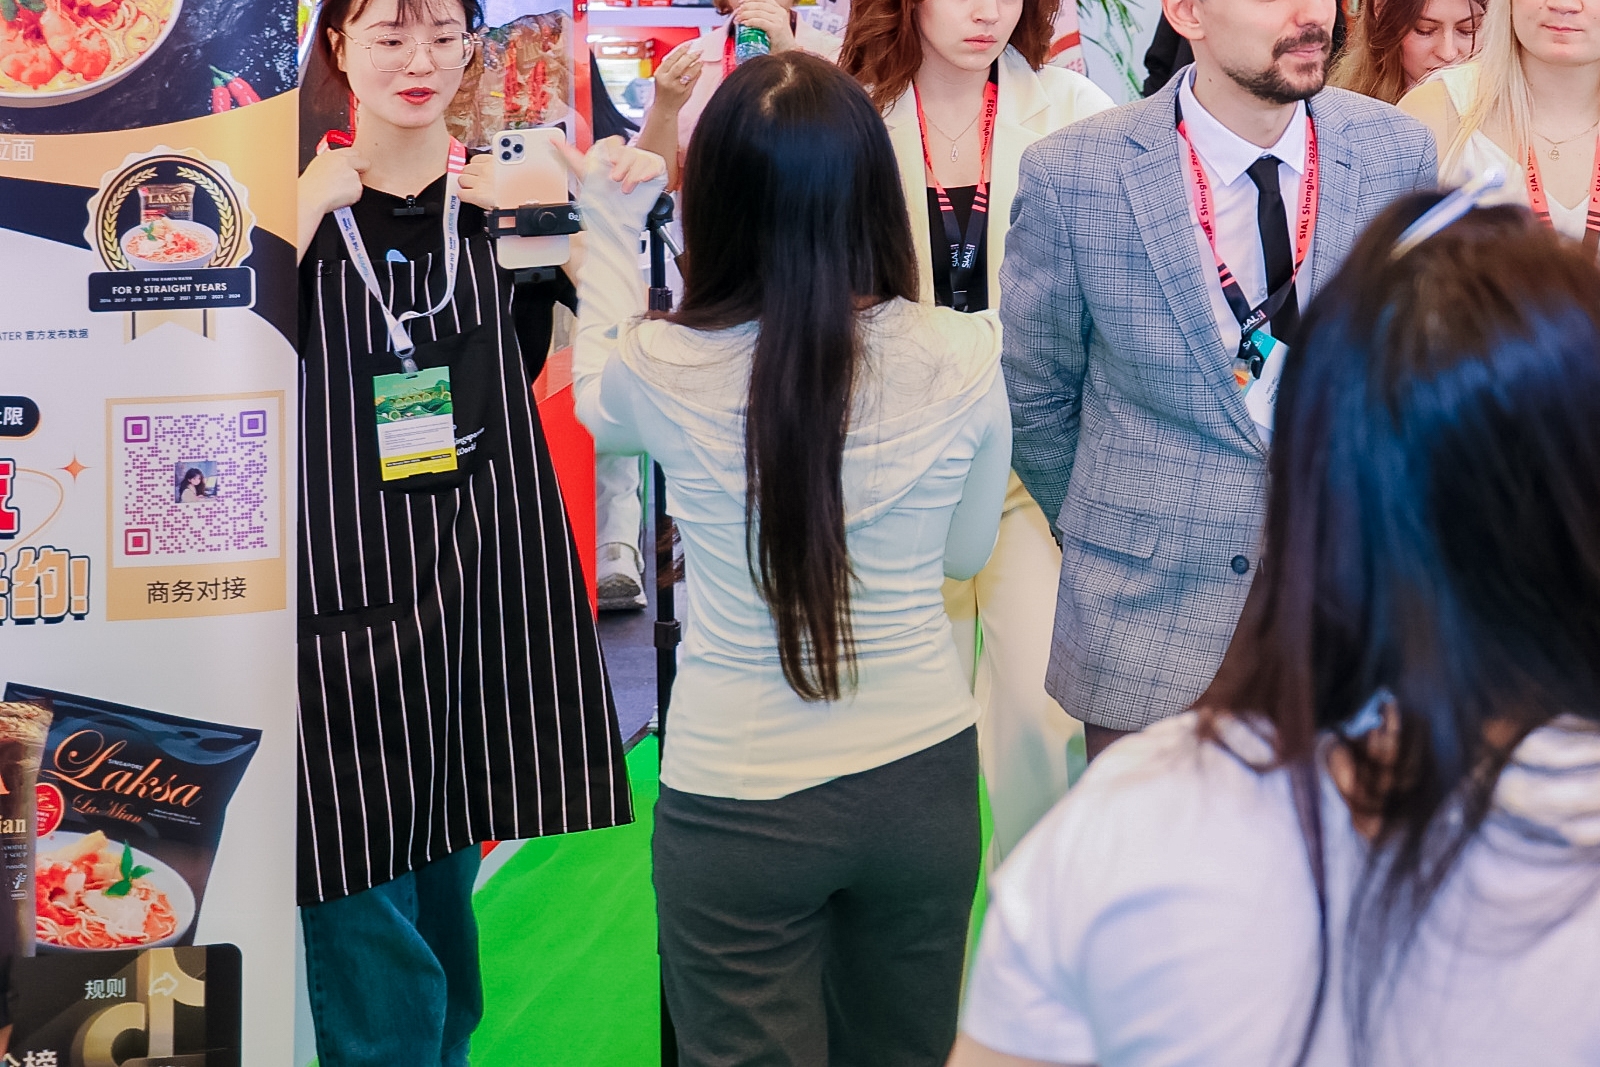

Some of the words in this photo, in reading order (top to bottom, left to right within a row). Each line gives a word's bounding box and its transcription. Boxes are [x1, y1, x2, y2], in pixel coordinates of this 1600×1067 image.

[1308, 140, 1316, 165] 2025
[1302, 168, 1315, 216] Shanghai
[1299, 218, 1309, 240] SIAL
[112, 286, 133, 295] FOR
[134, 286, 141, 294] 9
[143, 284, 193, 294] STRAIGHT
[194, 282, 228, 292] YEARS
[0, 331, 22, 341] TER
[25, 328, 89, 341] 官方发布数据
[0, 406, 24, 426] 限
[0, 547, 90, 624] 约!
[146, 575, 247, 604] 商务对接
[40, 730, 202, 808] Laksa
[107, 758, 144, 771] SINGAPORE
[84, 977, 127, 1000] 规则
